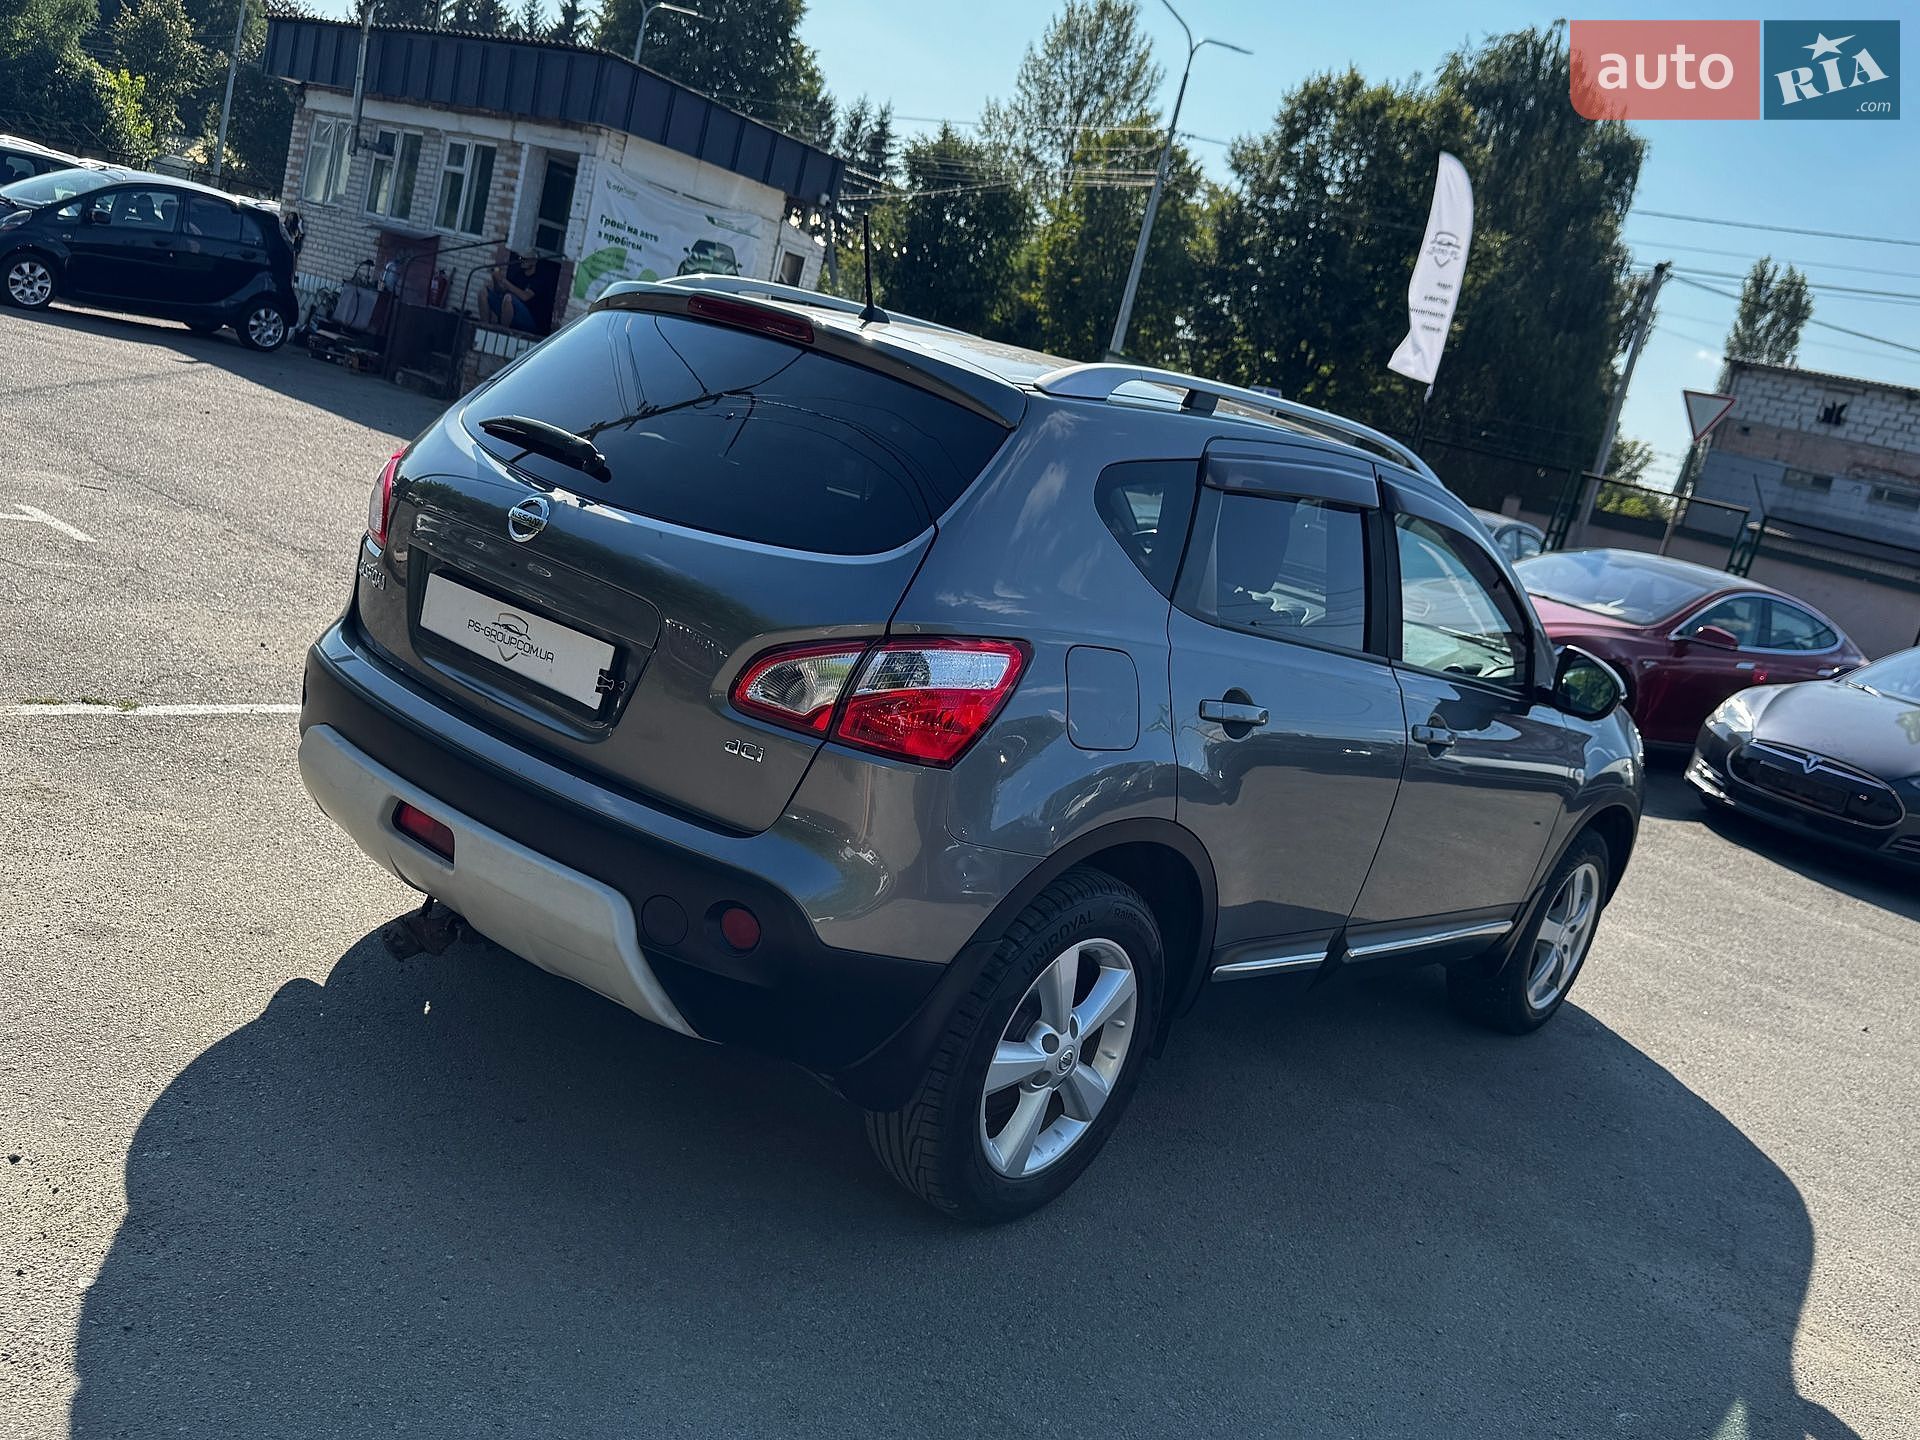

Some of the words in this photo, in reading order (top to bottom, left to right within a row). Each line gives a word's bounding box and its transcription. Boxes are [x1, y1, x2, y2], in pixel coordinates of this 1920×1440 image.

[600, 214, 627, 231] Гроші
[627, 224, 639, 236] на
[639, 230, 659, 243] авто
[603, 232, 643, 252] пробігом
[511, 508, 544, 532] NISSAN
[467, 618, 555, 663] PS-GROUP.COM.UA
[1022, 909, 1096, 976] UNIROYAL
